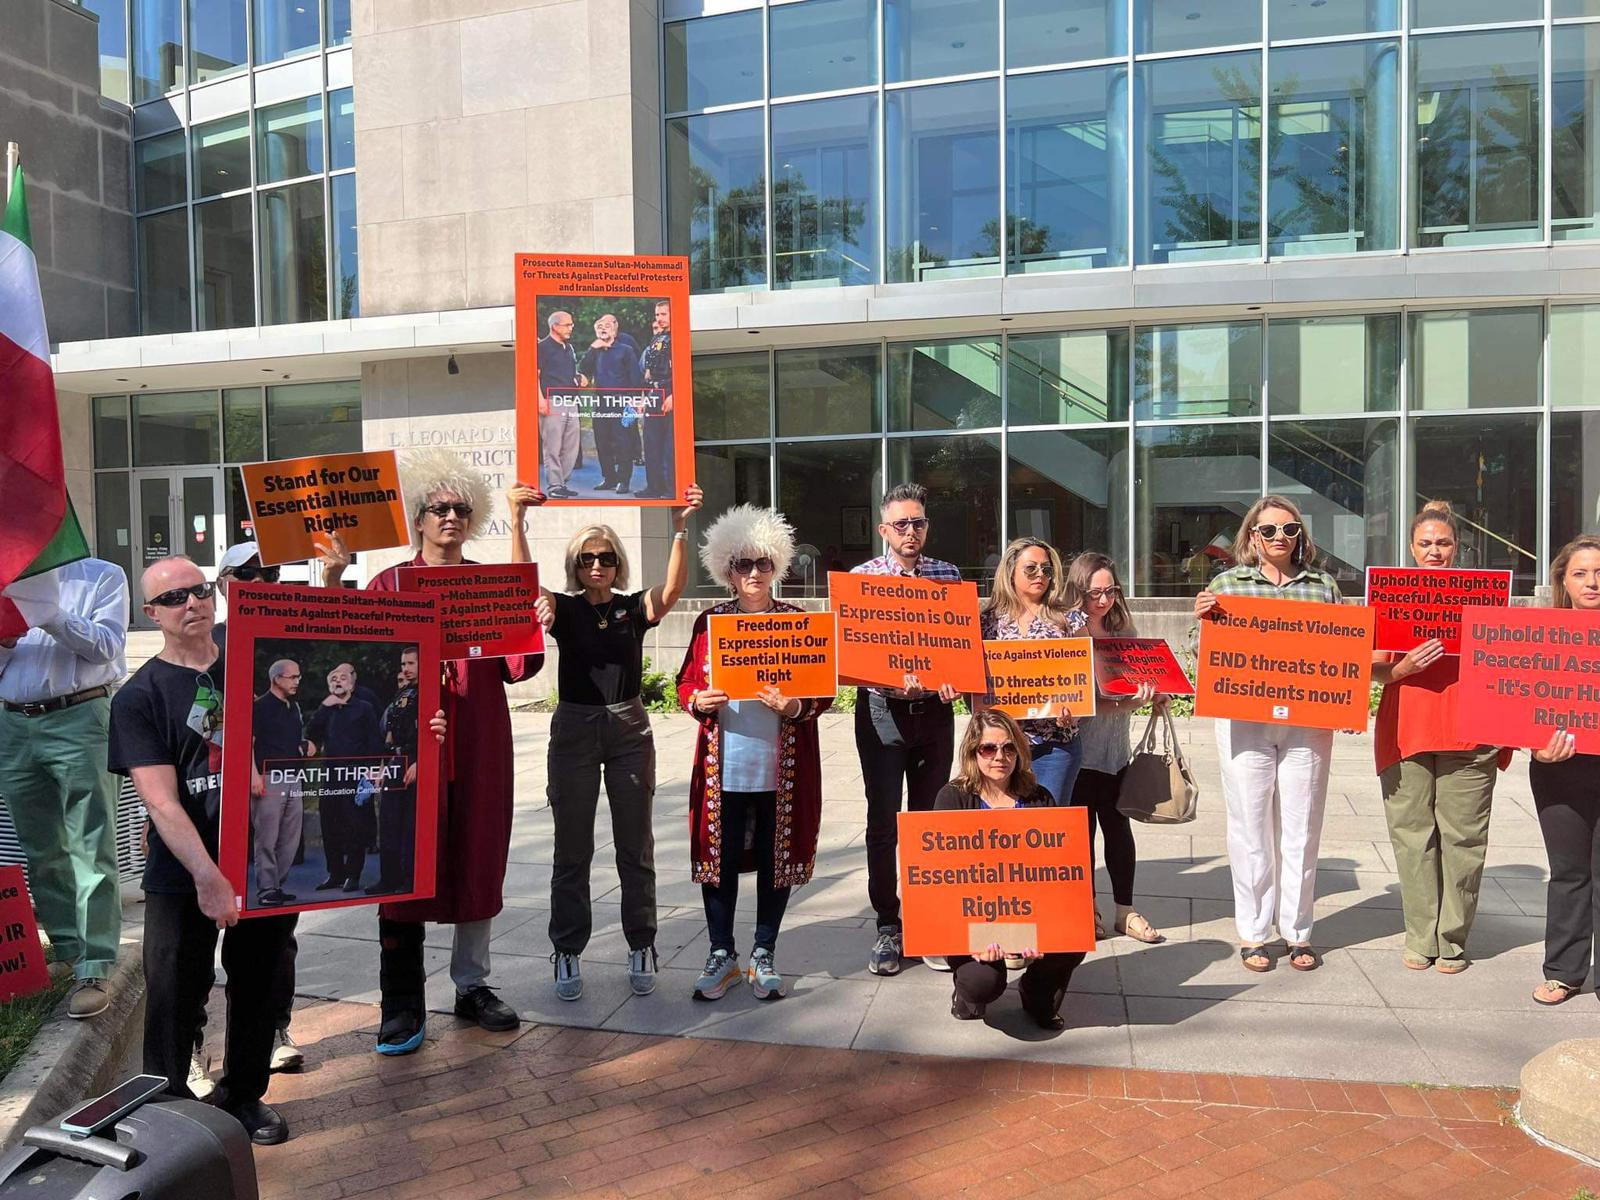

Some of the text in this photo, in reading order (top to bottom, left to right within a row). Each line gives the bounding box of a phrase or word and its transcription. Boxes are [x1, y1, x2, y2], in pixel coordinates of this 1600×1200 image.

[522, 258, 682, 270] Prosecute Ramezan Sultan-Mohammadi
[523, 270, 682, 282] for Threats Against Peaceful Protesters
[559, 283, 648, 293] and Iranian Dissidents
[552, 395, 659, 408] DEATH THREAT
[389, 432, 404, 448] L.
[410, 428, 494, 446] LEONARD
[264, 466, 380, 493] Stand for Our
[256, 488, 397, 517] Essential Human
[304, 512, 358, 534] Rights
[418, 574, 522, 588] Prosecute Ramezan
[1370, 574, 1508, 592] Uphold the Right to
[238, 589, 434, 609] Prosecute Ramezan Sultan-Mohammadi
[441, 586, 531, 601] -Mohammadi for
[861, 581, 948, 601] Freedom of
[1371, 590, 1505, 606] Peaceful Assembly
[238, 605, 434, 624] for Threats Against Peaceful Protesters
[450, 602, 492, 617] Against
[493, 601, 534, 612] Peacefu
[840, 604, 972, 626] Expression is Our
[1388, 607, 1410, 620] It's
[1412, 608, 1440, 622] Our
[1442, 610, 1462, 622] Hu
[284, 623, 395, 636] and Iranian Dissidents
[441, 614, 531, 630] sters and Iranian
[736, 617, 810, 632] Freedom of
[1210, 613, 1365, 638] Voice Against Violence
[446, 630, 502, 643] Dissidents
[844, 627, 972, 650] Essential Human
[1413, 625, 1457, 640] Right!
[1472, 624, 1600, 646] Uphold the R
[718, 634, 828, 652] Expression is Our
[722, 652, 826, 666] Essential Human
[888, 654, 932, 673] Right
[1004, 649, 1042, 662] Against
[1044, 648, 1087, 659] Violence
[1128, 654, 1165, 665] Regime
[1209, 650, 1360, 678] END threats to IR
[1473, 650, 1600, 674] Peaceful Ass
[756, 669, 792, 685] Right
[1154, 666, 1166, 674] on
[986, 674, 1087, 689] ND threats to IR
[1498, 678, 1530, 697] It's
[1534, 681, 1574, 700] Our
[1051, 690, 1083, 704] now!
[1214, 678, 1352, 706] dissidents now!
[1534, 708, 1598, 732] Right!
[270, 765, 400, 784] DEATH THREAT
[290, 786, 381, 798] Islamic Education Center
[922, 828, 1066, 852] Stand for Our
[908, 862, 1084, 886] Essential Human
[962, 896, 1032, 922] Rights
[6, 922, 26, 942] IR
